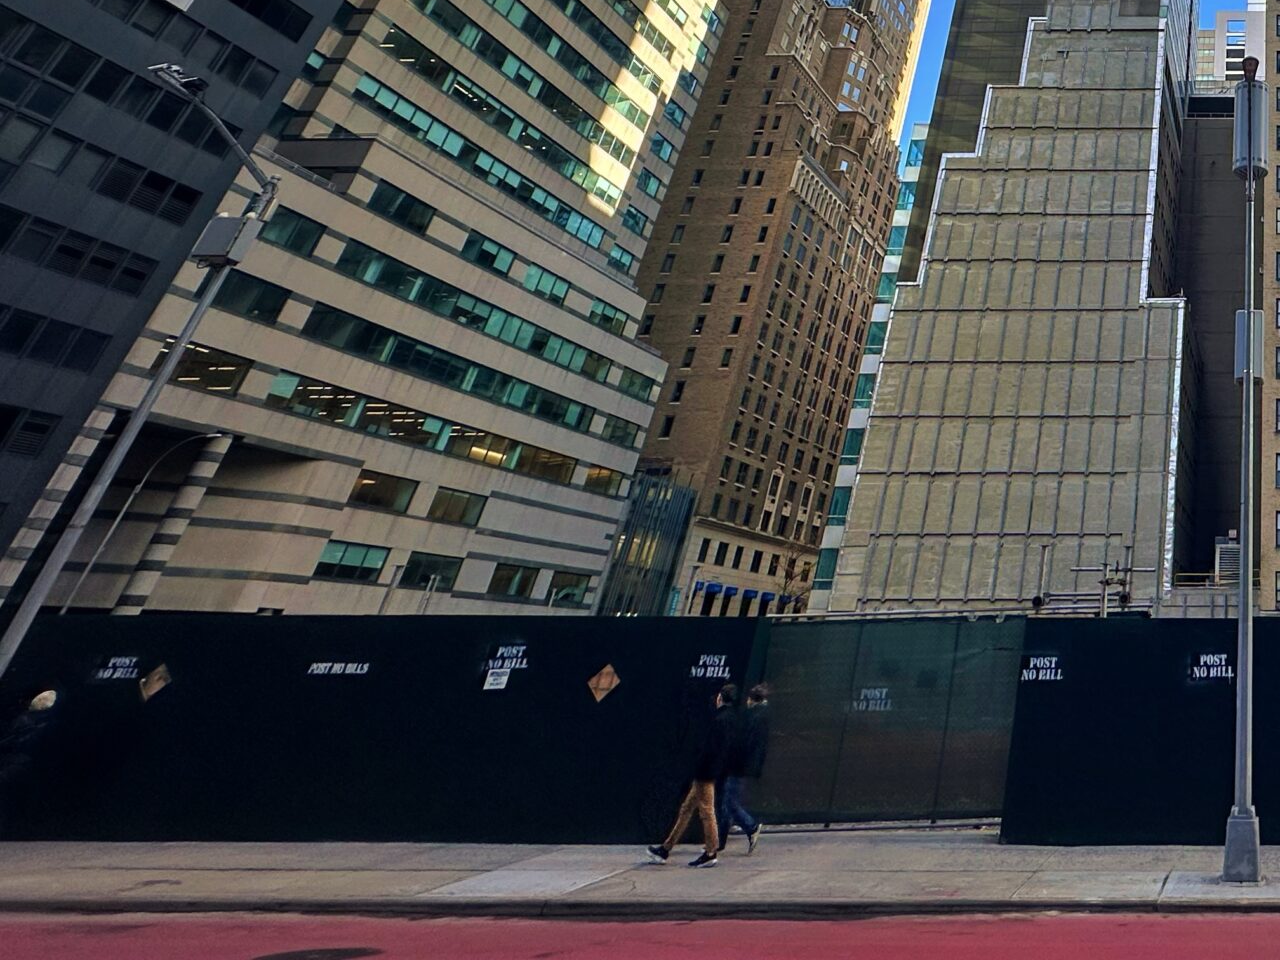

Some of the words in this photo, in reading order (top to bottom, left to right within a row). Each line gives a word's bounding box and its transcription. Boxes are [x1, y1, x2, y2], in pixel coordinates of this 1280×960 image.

[496, 645, 527, 658] POST
[108, 656, 139, 668] POST
[503, 657, 528, 669] BILL
[699, 654, 727, 666] POST
[1030, 656, 1058, 668] POST
[1200, 654, 1228, 666] POST
[307, 662, 333, 674] POST
[330, 662, 346, 674] NO
[689, 666, 705, 678] NO
[705, 666, 731, 678] BILL
[1192, 666, 1208, 678] NO
[1209, 666, 1235, 678] BILL
[1021, 669, 1037, 681] NO
[1038, 668, 1064, 681] BILL
[860, 687, 889, 700] POST
